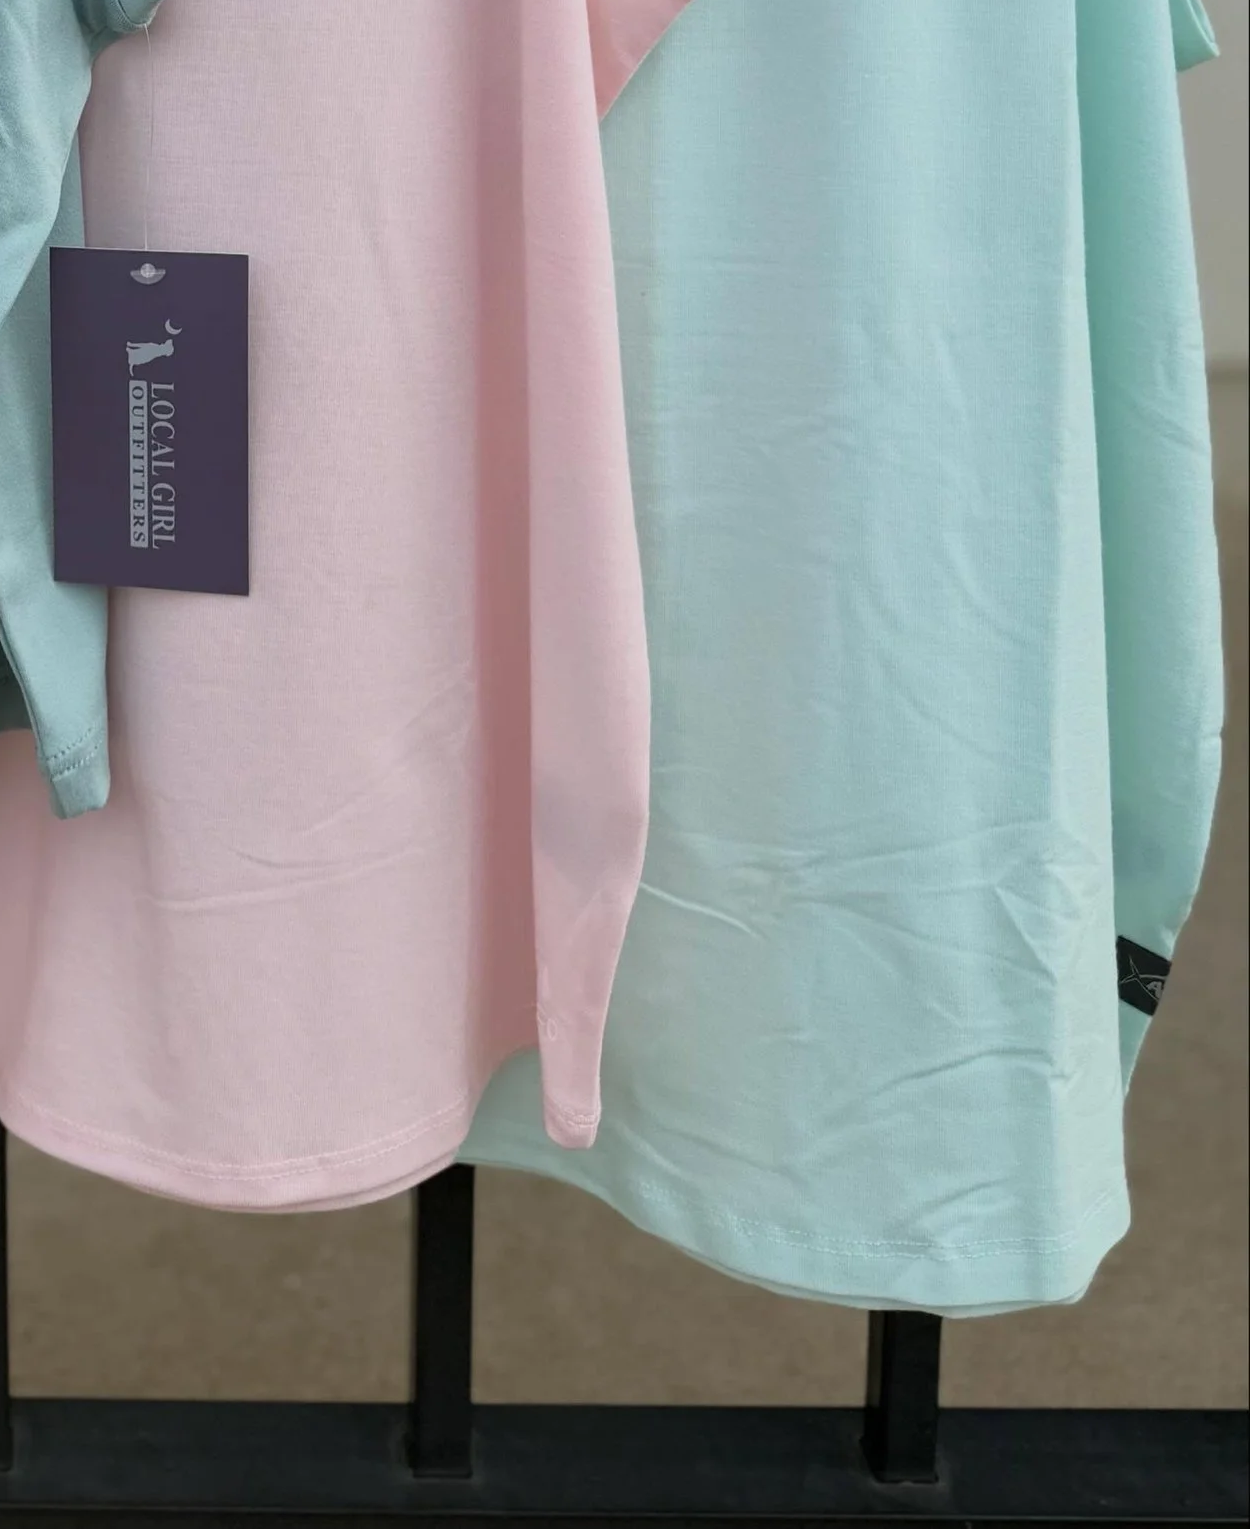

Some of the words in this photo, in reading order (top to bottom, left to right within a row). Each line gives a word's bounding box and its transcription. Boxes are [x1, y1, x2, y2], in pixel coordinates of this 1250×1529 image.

[131, 384, 146, 543] OUTFITTERS
[151, 381, 175, 476] LOCAL
[151, 482, 176, 549] GIRL
